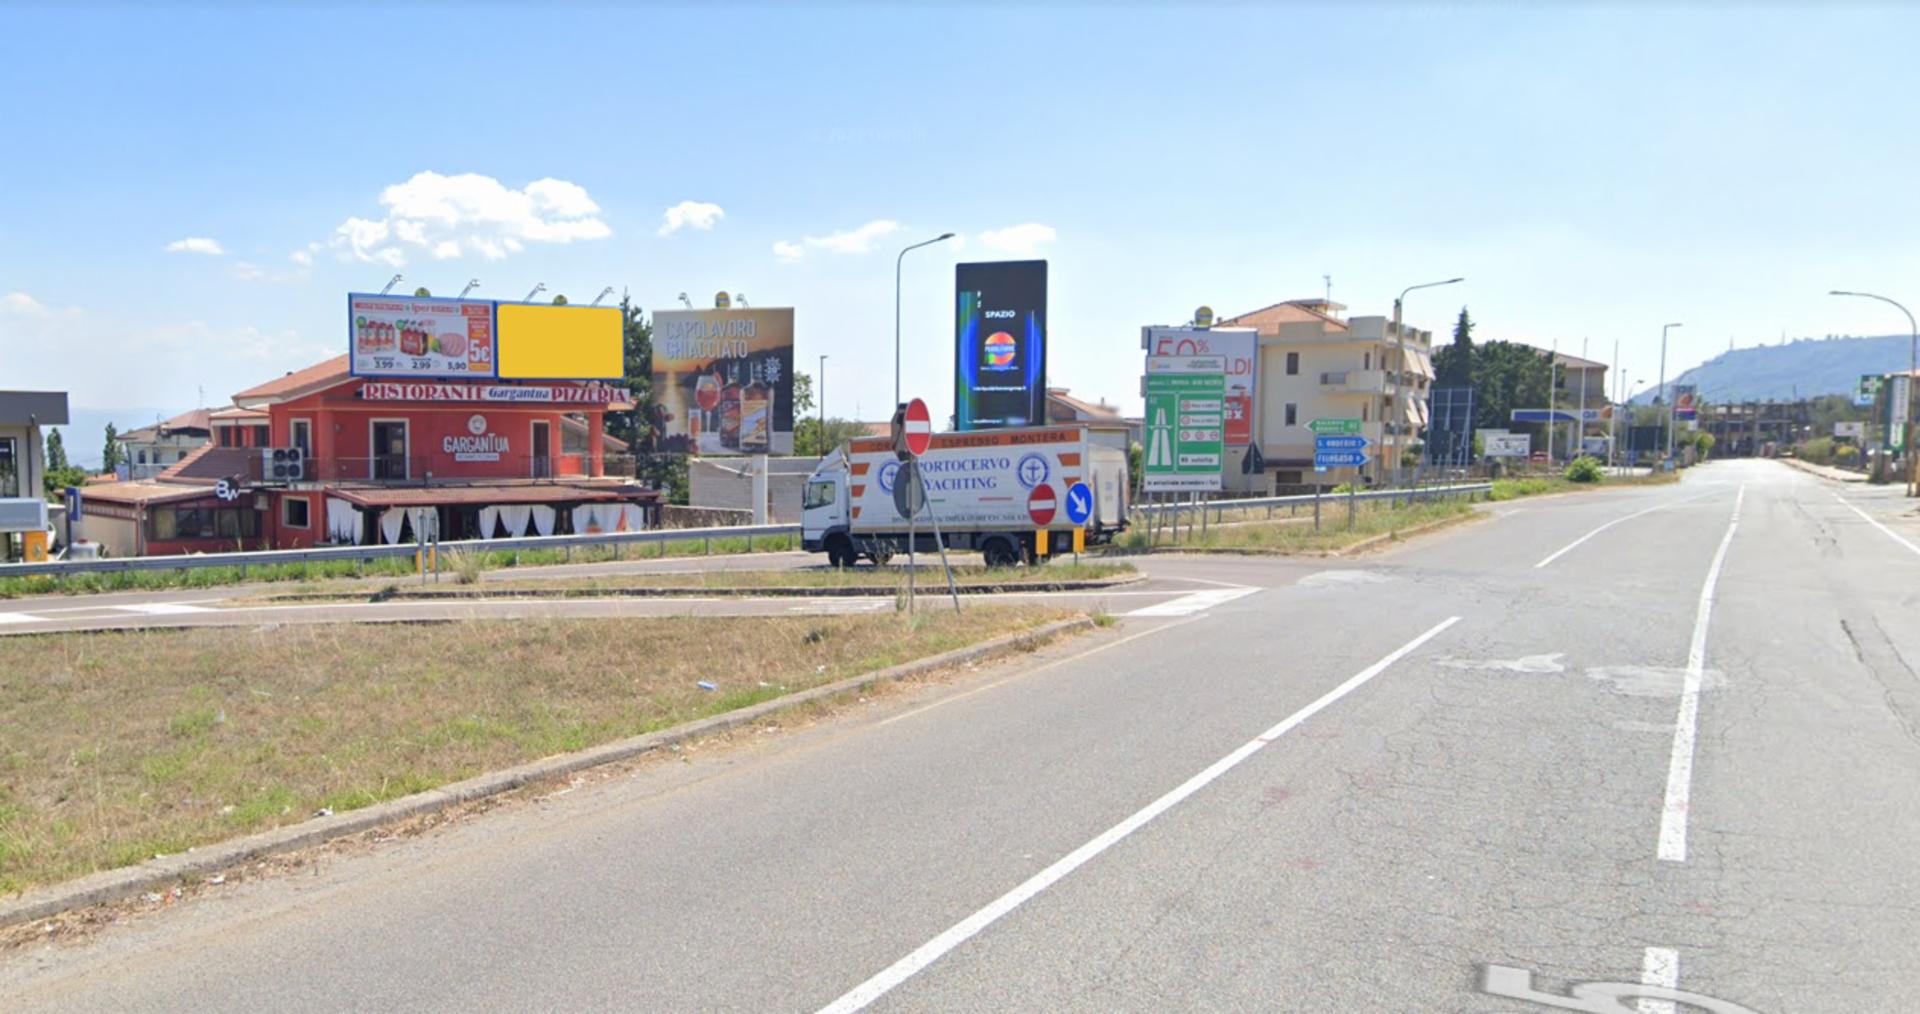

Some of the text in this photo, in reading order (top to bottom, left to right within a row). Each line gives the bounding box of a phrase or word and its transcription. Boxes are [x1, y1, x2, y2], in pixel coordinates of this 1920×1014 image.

[985, 310, 1015, 318] SPAZIO
[665, 319, 757, 340] CAPOLAVORO
[665, 339, 749, 360] GHIACCIATO
[1224, 358, 1252, 375] LDI
[364, 383, 627, 402] RISTORANTE Gargantua PIZZERIA
[443, 432, 510, 454] GARGANTUA
[941, 431, 1066, 449] ESPRESSO MONTERA
[923, 476, 997, 491] YACHTING
